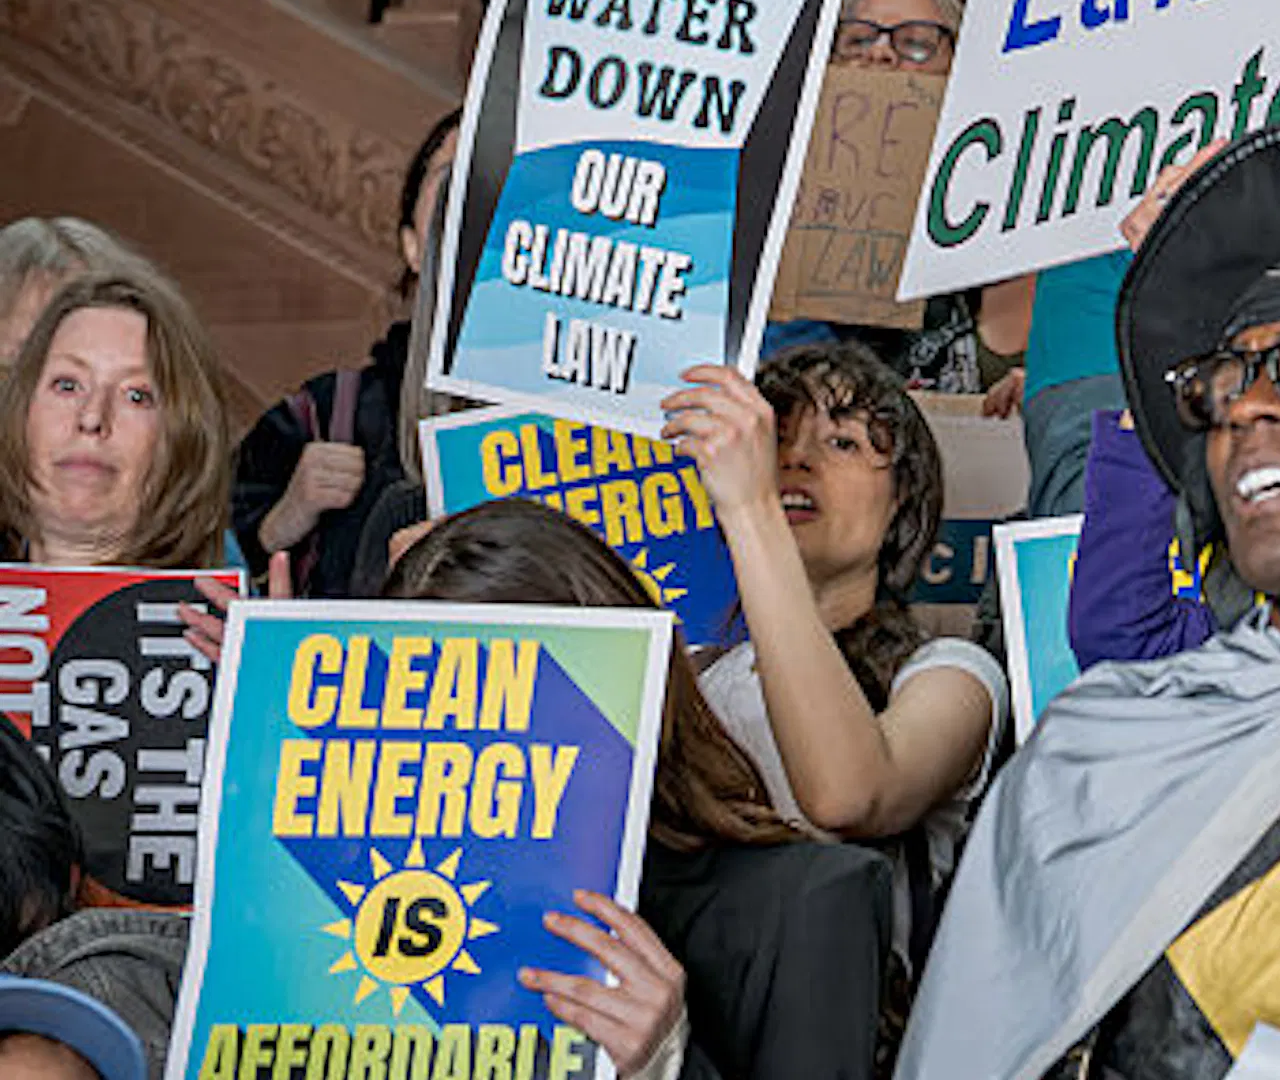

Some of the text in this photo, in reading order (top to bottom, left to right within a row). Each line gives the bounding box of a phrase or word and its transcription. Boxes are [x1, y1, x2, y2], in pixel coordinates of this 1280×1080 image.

[539, 46, 748, 135] DOWN
[570, 148, 668, 229] OUR
[500, 219, 694, 321] CLIMATE
[542, 312, 639, 396] LAW
[56, 657, 132, 801] GAS
[286, 633, 543, 733] CLEAN
[125, 736, 208, 886] THE
[271, 737, 580, 840] ENERGY
[371, 897, 450, 961] IS
